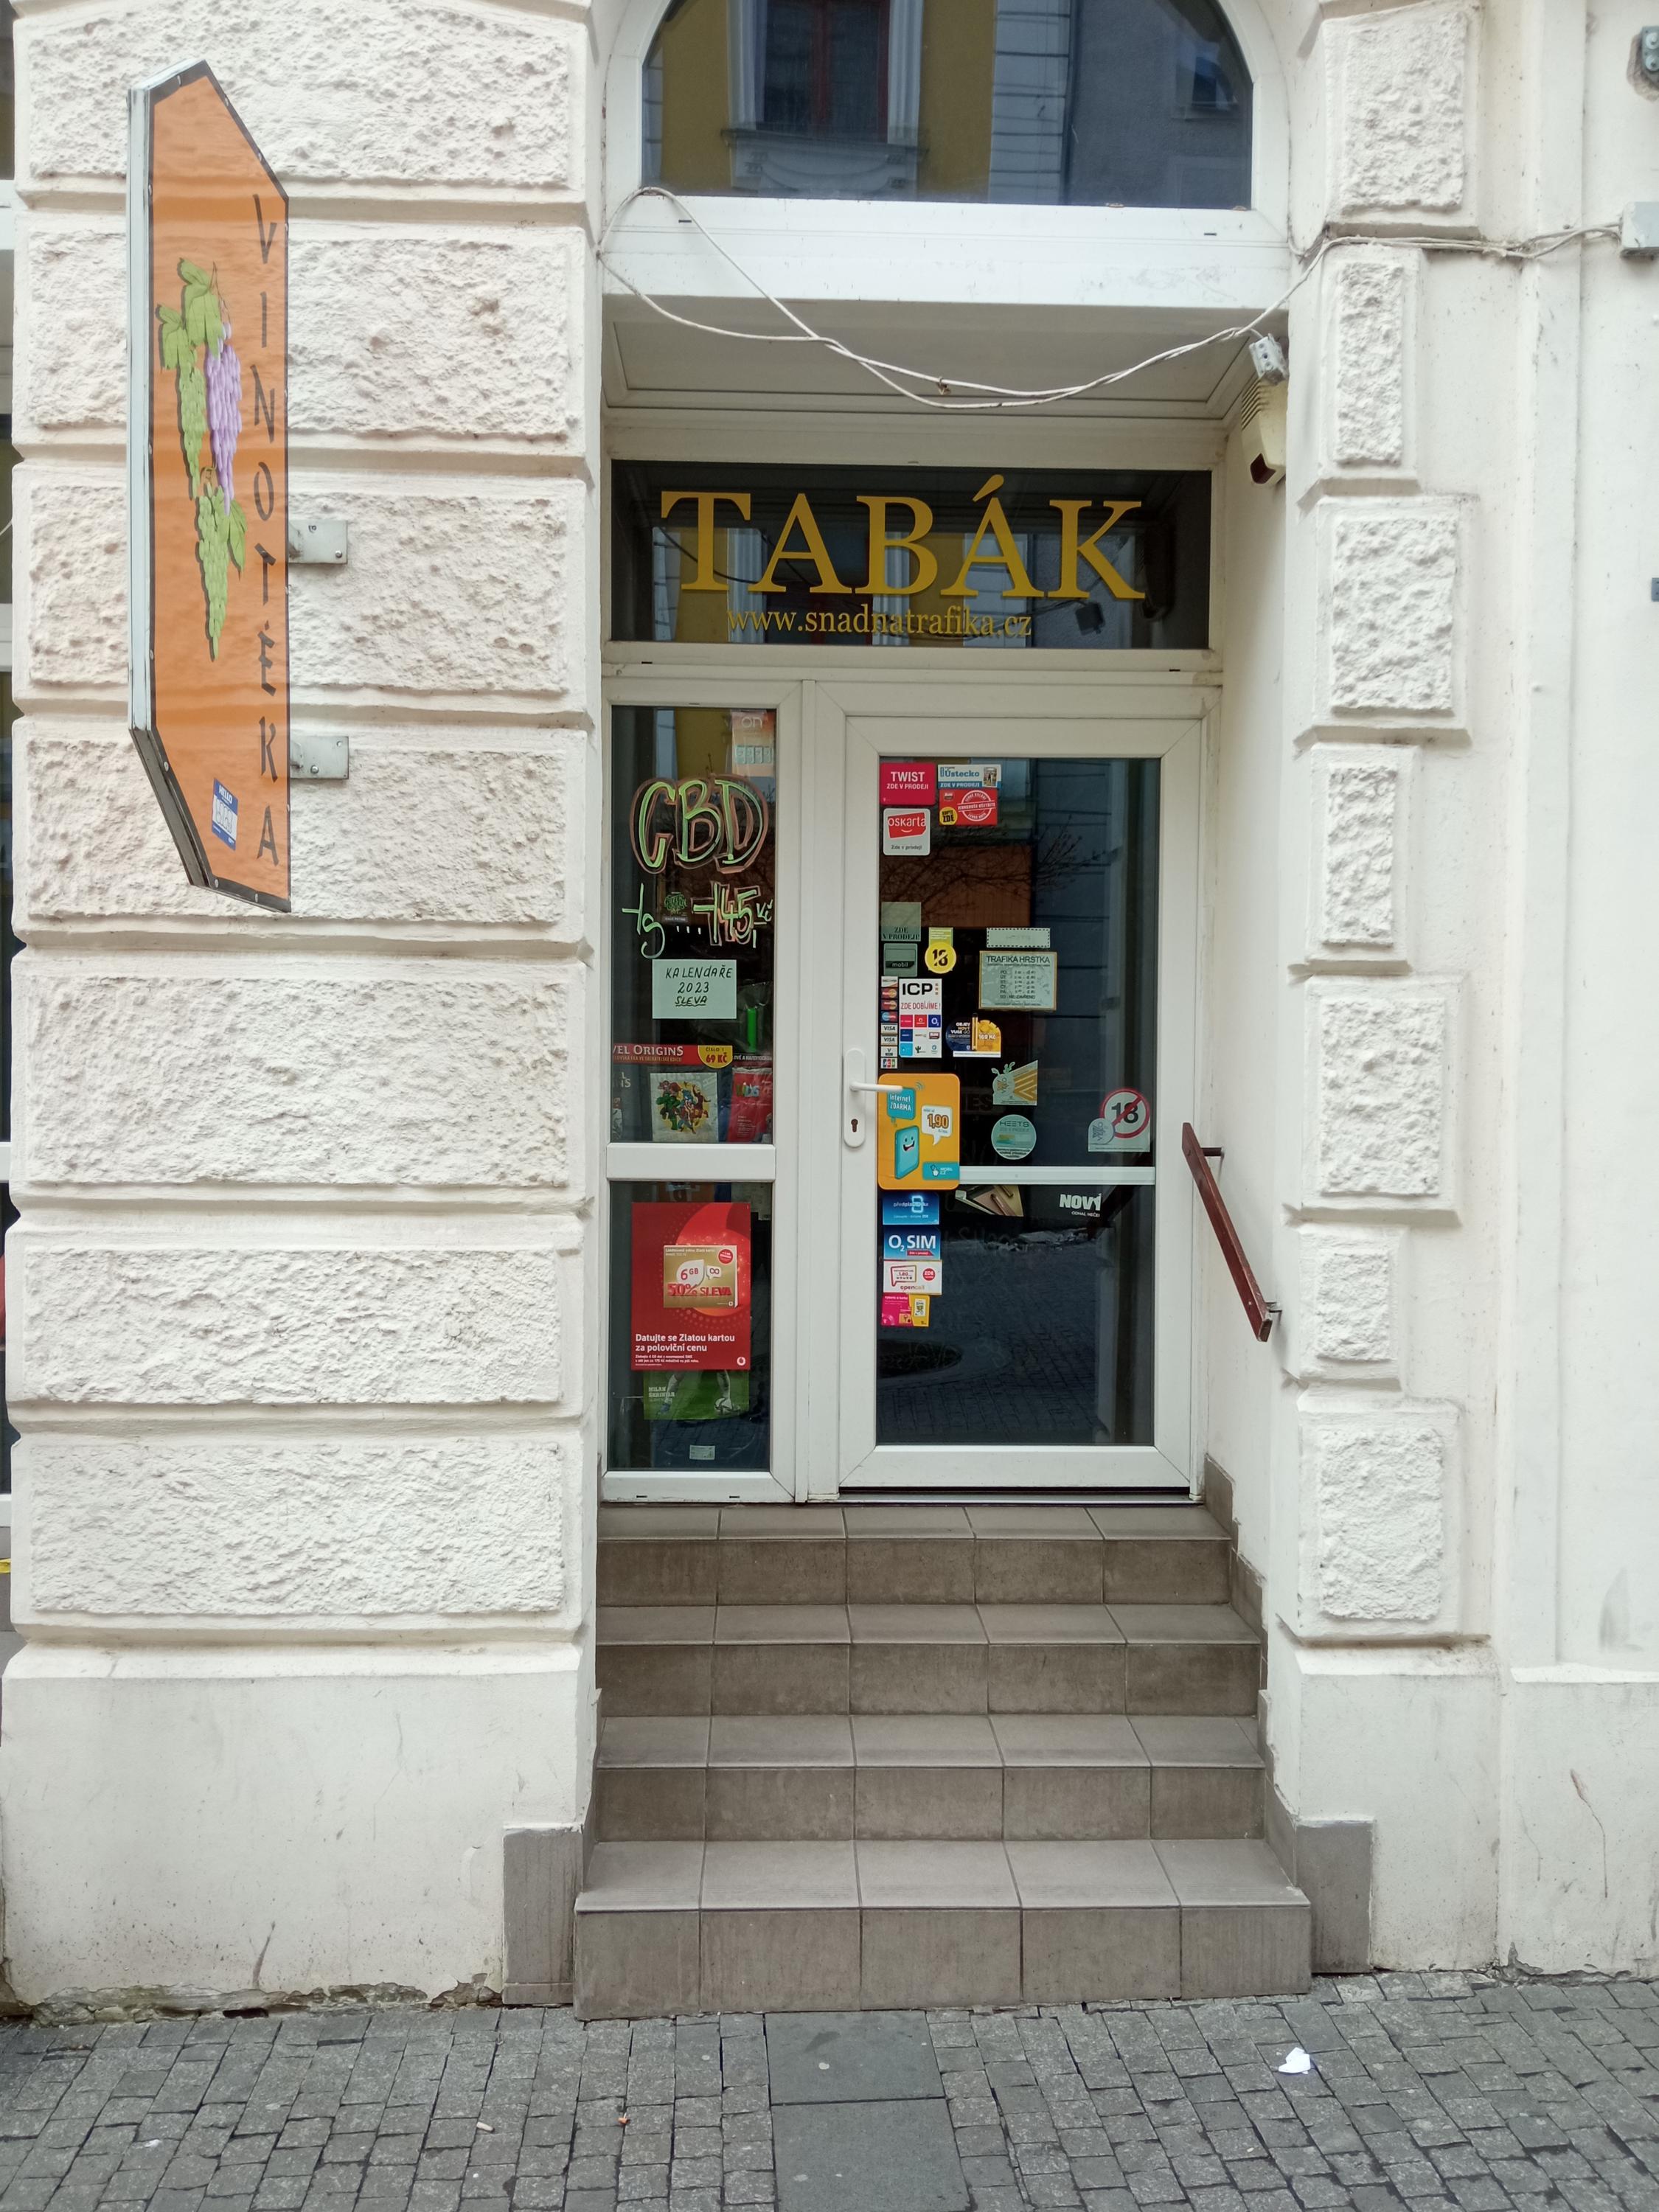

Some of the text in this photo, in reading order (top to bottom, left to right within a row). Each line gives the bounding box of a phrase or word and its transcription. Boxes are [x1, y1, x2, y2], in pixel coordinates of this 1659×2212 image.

[661, 474, 1145, 599] TABÁK
[727, 604, 1032, 638] www.snadnatrafika.cz
[891, 771, 925, 782] TWIST
[219, 785, 233, 804] HELLO
[630, 774, 769, 874] CBD
[888, 814, 927, 827] oskarta
[932, 948, 948, 967] 18
[987, 955, 1051, 964] TRAFIKA HRSTKA
[678, 981, 709, 994] 2023
[902, 982, 933, 995] ICP
[675, 995, 708, 1005] SLEVA
[633, 1044, 684, 1056] ORIGINS
[706, 1054, 716, 1063] 69
[890, 1093, 911, 1103] Internet
[890, 1102, 911, 1112] ZDARMA
[1111, 1102, 1138, 1123] 18
[927, 1113, 949, 1129] 1,90
[1059, 1193, 1102, 1211] NOVÝ
[888, 1234, 936, 1252] O2 SIM
[681, 1268, 689, 1281] 6
[667, 1282, 733, 1297] 50% SLEVA
[635, 1333, 667, 1343] Datujte
[678, 1333, 706, 1342] Zlatou
[708, 1333, 736, 1342] kartou
[647, 1343, 685, 1353] poloviční
